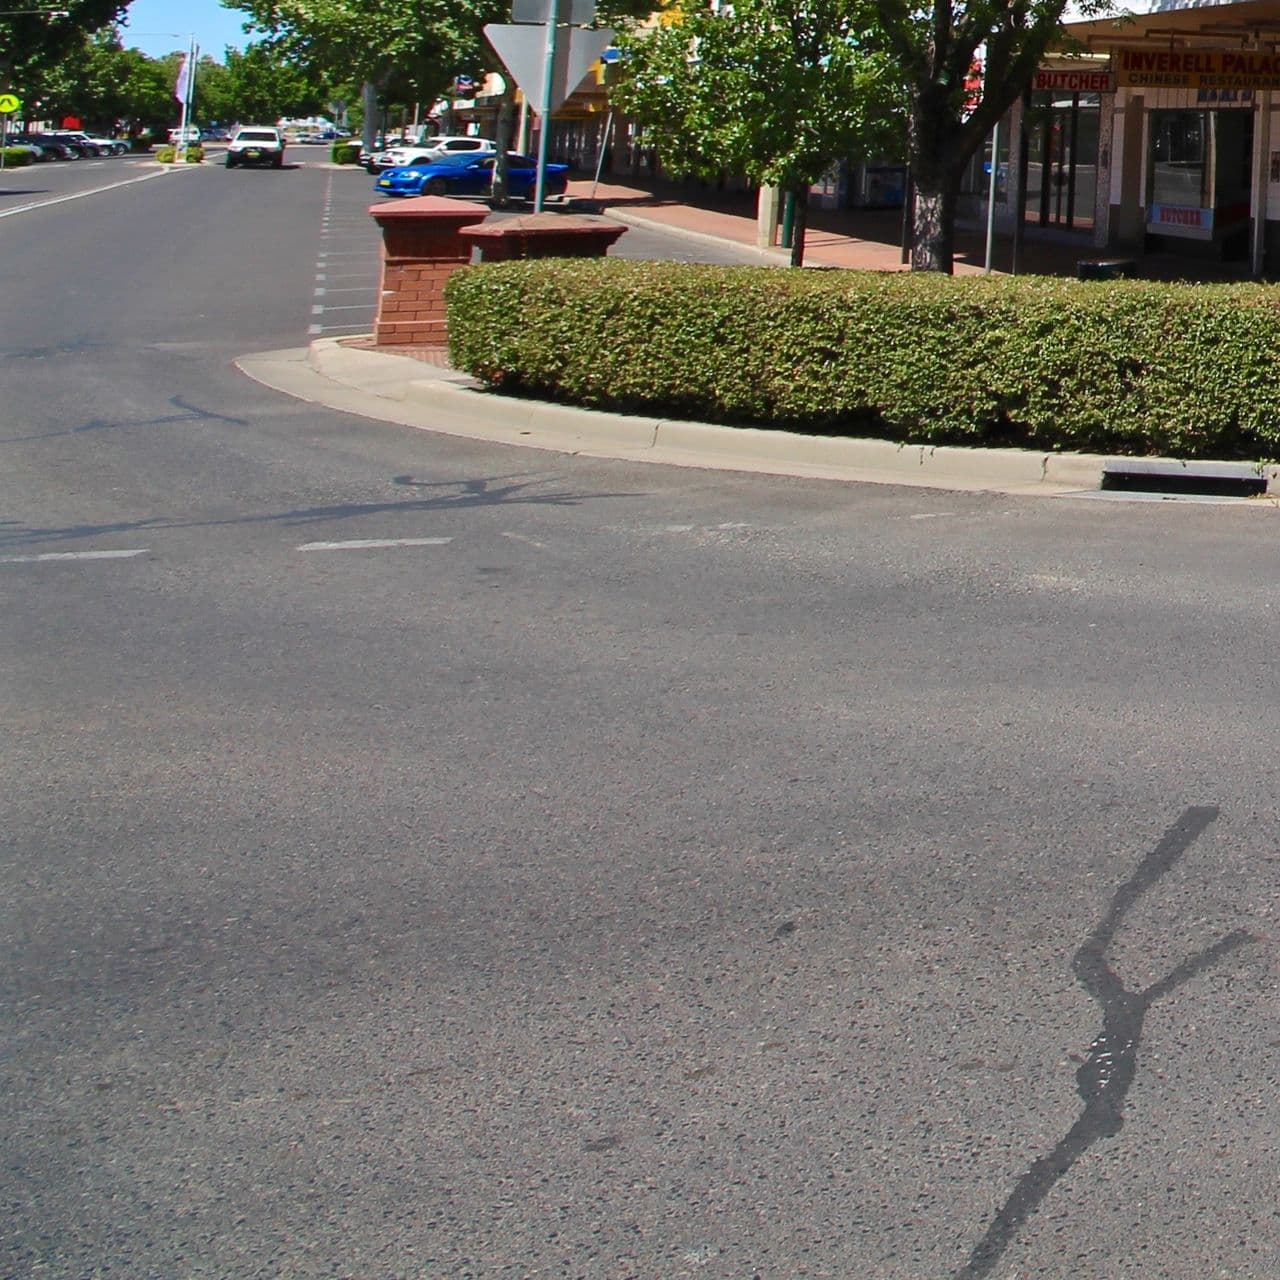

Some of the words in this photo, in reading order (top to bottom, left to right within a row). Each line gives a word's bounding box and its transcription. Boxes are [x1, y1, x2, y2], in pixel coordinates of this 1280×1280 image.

[1123, 50, 1214, 73] INVERELL
[1036, 71, 1110, 90] BUTCHER
[1128, 72, 1191, 86] CHINESE
